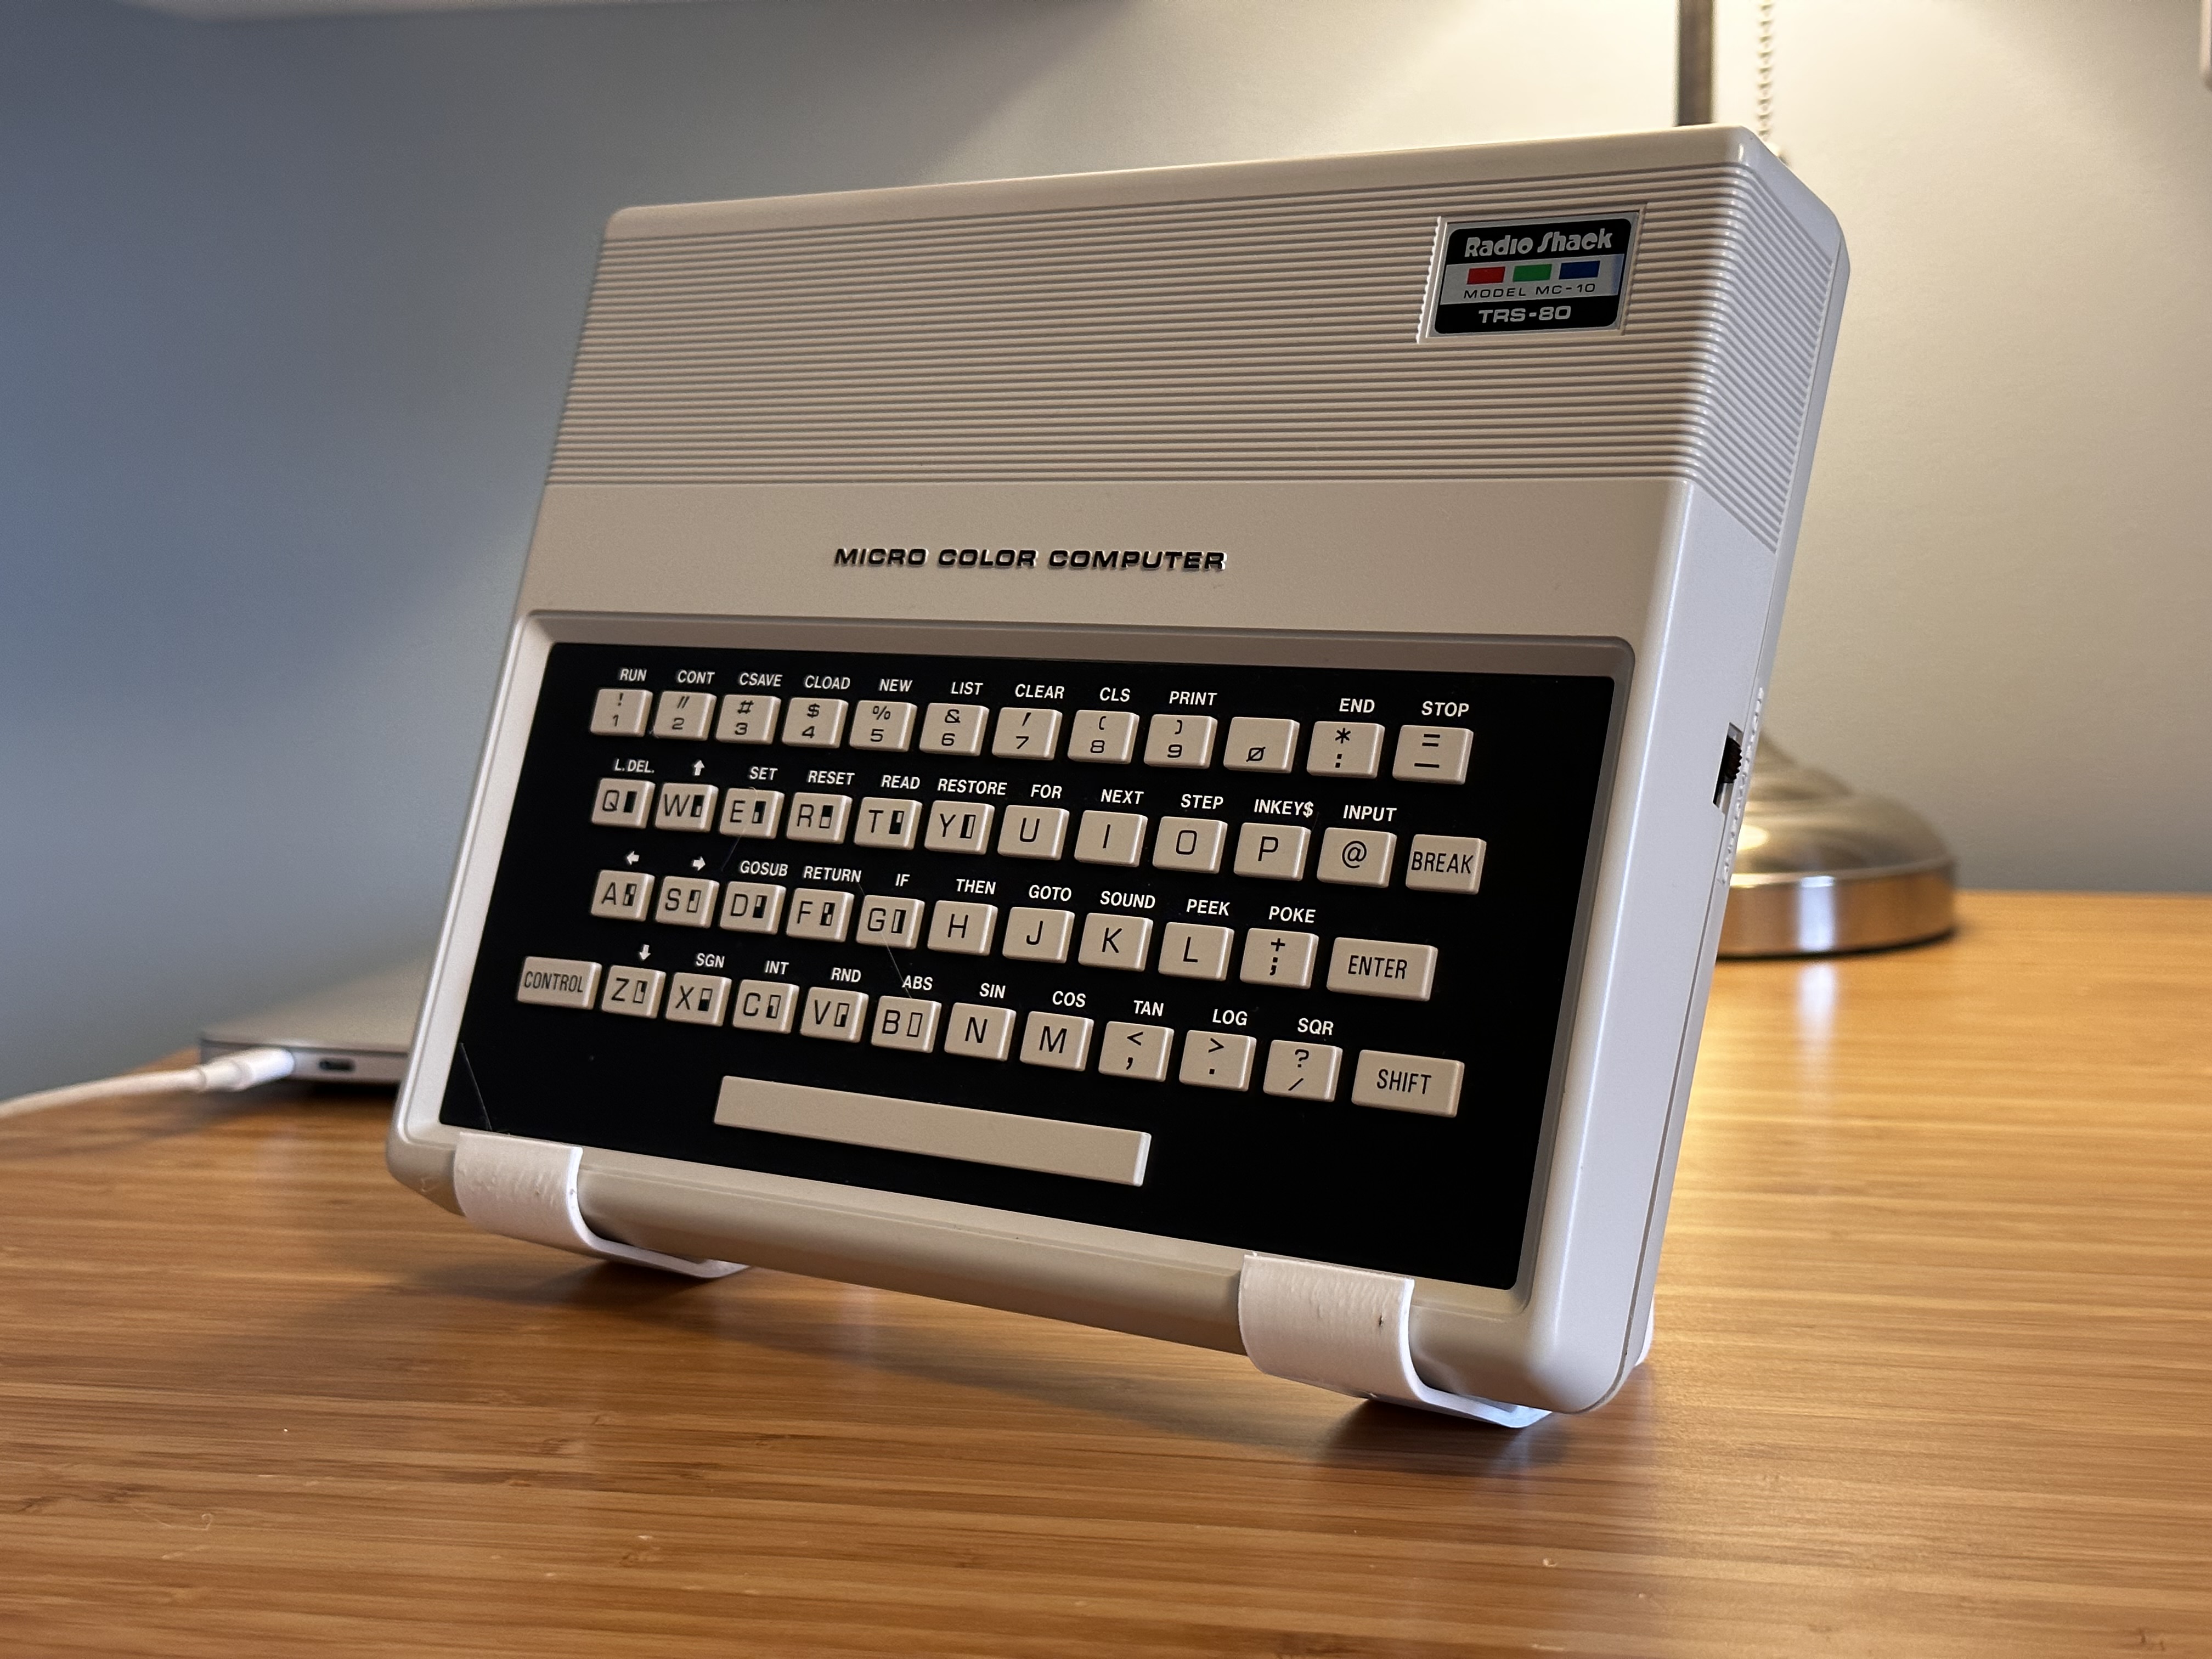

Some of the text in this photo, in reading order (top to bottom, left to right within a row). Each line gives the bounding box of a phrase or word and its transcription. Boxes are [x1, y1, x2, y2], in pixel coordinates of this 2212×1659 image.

[1464, 228, 1613, 258] Radio Shack
[1463, 283, 1595, 299] MODEL MC-10
[1478, 306, 1572, 324] TRS-80
[834, 548, 1224, 571] MICRO COLOR COMPUTER
[619, 668, 647, 681] RUN
[677, 670, 715, 684] CONT
[739, 672, 783, 687] CSAVE
[804, 675, 850, 690] CLOAD
[879, 679, 913, 692] NEW
[951, 681, 984, 695] LIST
[1015, 684, 1065, 699] CLEAR
[618, 693, 623, 706] !
[1099, 687, 1131, 702] CLS
[1169, 691, 1218, 706] PRINT
[737, 701, 754, 714] #
[807, 703, 820, 718] $
[873, 706, 890, 720] %
[1339, 698, 1375, 713] END
[1421, 701, 1469, 717] STOP
[613, 715, 619, 726] 1
[672, 718, 684, 730] 2
[945, 709, 960, 723] &
[735, 723, 748, 735] 3
[802, 726, 814, 738] 4
[871, 729, 884, 742] 5
[941, 733, 955, 746] 6
[1016, 736, 1029, 749] 7
[1090, 740, 1105, 753] 8
[1167, 744, 1182, 758] 9
[749, 766, 778, 781] SET
[808, 770, 855, 785] RESET
[881, 775, 921, 789] READ
[937, 778, 1008, 795] RESTORE
[1030, 784, 1062, 799] FOR
[602, 790, 619, 812] Q
[1101, 789, 1144, 804] NEXT
[1181, 793, 1224, 810] STEP
[664, 794, 690, 817] W
[730, 800, 745, 823] E
[1254, 799, 1314, 818] INKEY$
[1343, 804, 1397, 822] INPUT
[797, 804, 814, 827] R
[869, 810, 884, 833] T
[940, 814, 956, 837] Y
[1020, 818, 1040, 842] U
[1103, 825, 1110, 848] I
[1176, 830, 1197, 855] O
[1258, 836, 1278, 861] P
[1342, 841, 1367, 868] @
[740, 860, 788, 877] GOSUB
[1411, 851, 1474, 874] BREAK
[803, 866, 862, 883] RETURN
[895, 873, 910, 887] IF
[601, 882, 616, 905] A
[956, 878, 996, 895] THEN
[1029, 884, 1072, 901] GOTO
[665, 888, 681, 911] S
[730, 894, 748, 916] D
[1100, 890, 1155, 909] SOUND
[1186, 899, 1231, 916] PEEK
[797, 901, 812, 924] F
[867, 908, 886, 932] G
[1268, 906, 1316, 923] POKE
[948, 914, 968, 938] H
[1026, 921, 1043, 945] J
[1102, 928, 1122, 953] K
[1183, 936, 1198, 962] L
[1271, 938, 1285, 951] +
[696, 952, 725, 968] SGN
[765, 960, 789, 975] INT
[1347, 955, 1408, 980] ENTER
[523, 970, 583, 993] CONTROL
[831, 967, 861, 983] RND
[901, 975, 933, 991] ABS
[611, 978, 629, 1001] Z
[675, 986, 694, 1010] X
[979, 983, 1006, 998] SIN
[743, 992, 760, 1016] C
[1052, 990, 1086, 1008] COS
[815, 1000, 831, 1024] V
[1133, 1000, 1164, 1017] TAN
[1212, 1008, 1248, 1026] LOG
[882, 1009, 900, 1034] B
[965, 1017, 988, 1043] N
[1297, 1018, 1334, 1036] SQR
[1040, 1026, 1067, 1053] M
[1127, 1032, 1143, 1046] <
[1209, 1038, 1224, 1053] >
[1295, 1049, 1309, 1068] ?
[1376, 1069, 1432, 1095] SHIFT
